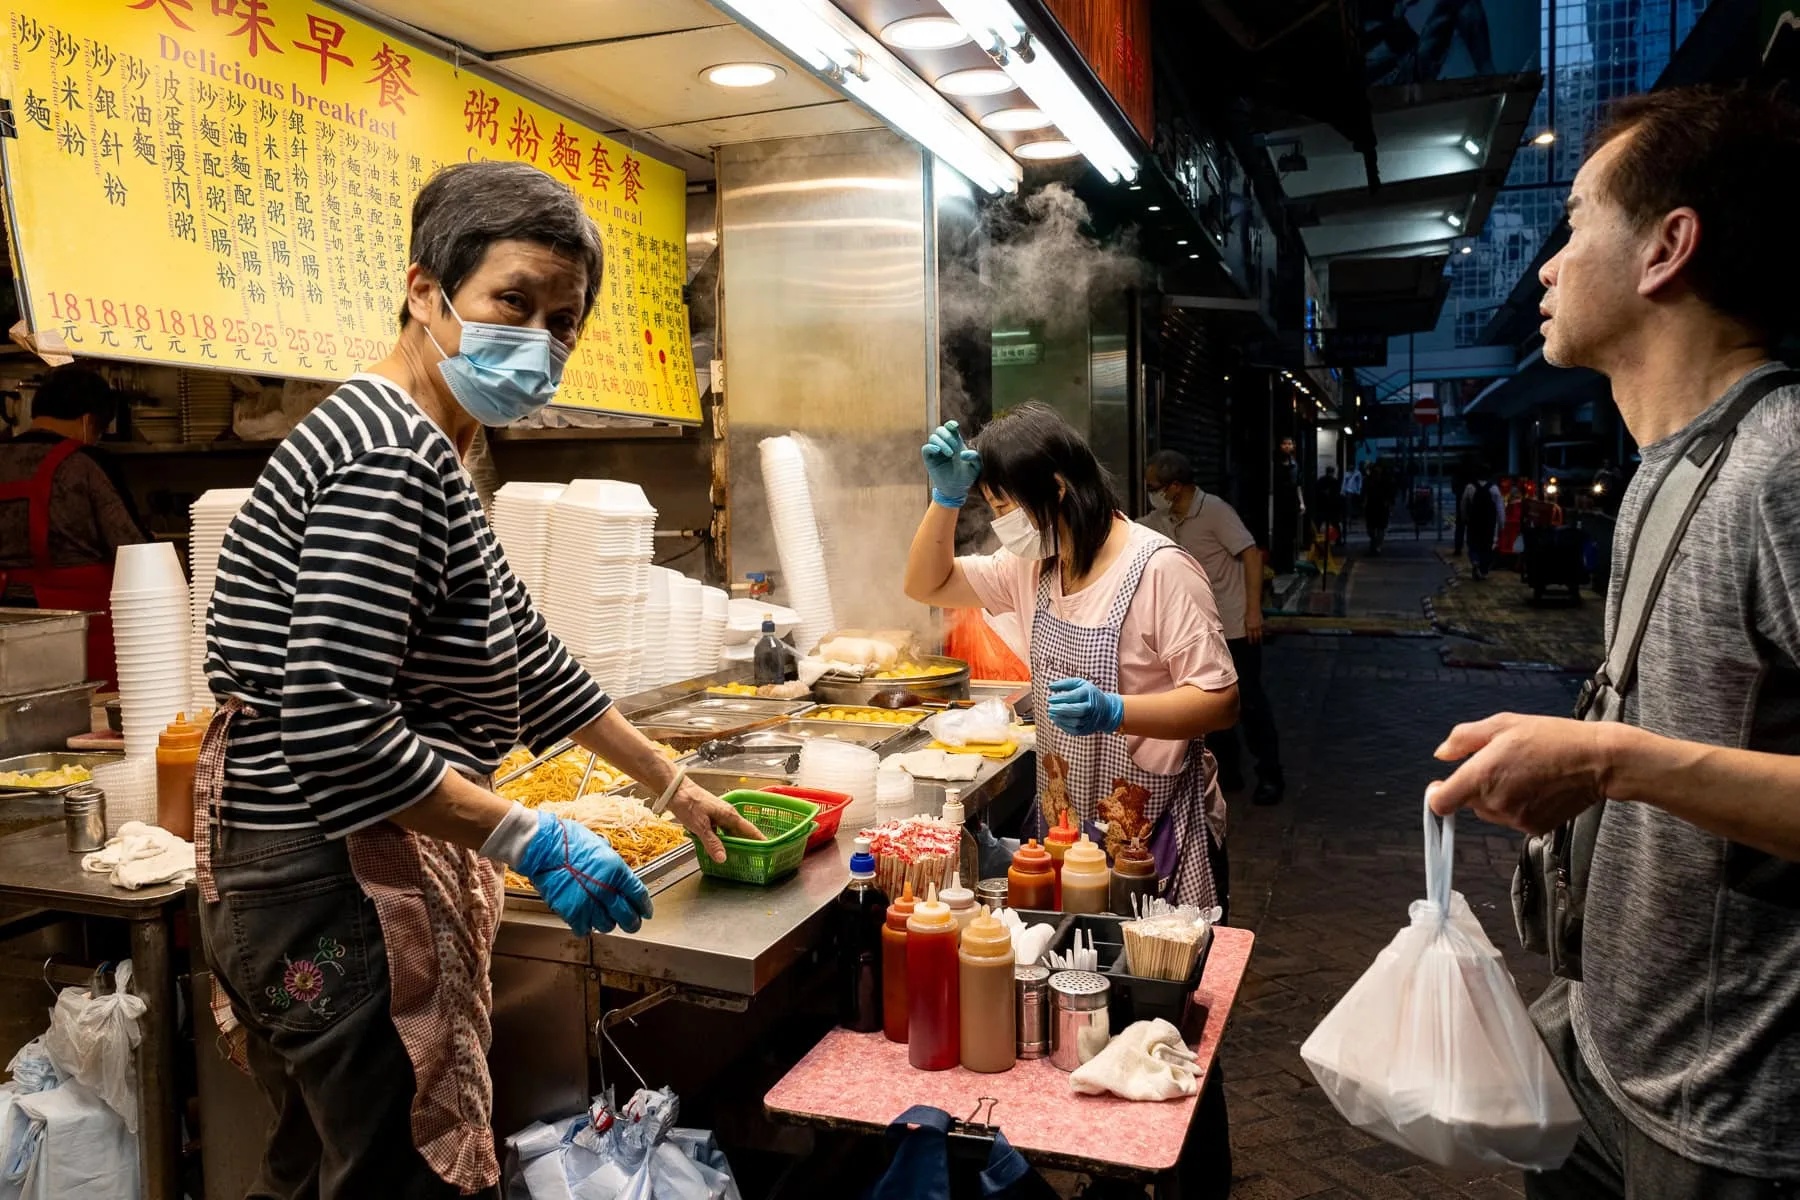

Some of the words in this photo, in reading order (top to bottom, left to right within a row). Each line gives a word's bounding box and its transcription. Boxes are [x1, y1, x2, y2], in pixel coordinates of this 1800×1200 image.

[18, 14, 54, 131] 炒麵
[55, 29, 87, 157] 炒米粉
[158, 33, 285, 100] Delicious
[292, 82, 398, 141] breakfast
[91, 40, 128, 207] 炒銀針粉
[127, 55, 159, 166] 炒油麵
[162, 69, 196, 244] 皮蛋瘦肉粥
[464, 88, 646, 205] 粥粉麵套餐
[588, 196, 608, 215] set
[613, 207, 642, 226] meal
[48, 292, 81, 321] 18
[85, 298, 118, 327] 18
[119, 303, 150, 331] 18
[62, 319, 83, 343] 元
[156, 307, 186, 336] 18
[189, 313, 217, 340] 18
[222, 317, 249, 344] 25
[100, 325, 120, 347] 元
[134, 329, 152, 351] 元
[168, 335, 186, 353] 元
[252, 322, 278, 348] 25
[285, 327, 310, 352] 25
[298, 352, 313, 368] 元
[313, 330, 337, 356] 25
[343, 335, 365, 360] 25
[200, 338, 217, 359] 元
[235, 344, 251, 361] 元
[262, 348, 278, 364] 元
[581, 348, 594, 366] 15
[323, 356, 338, 371] 元
[585, 370, 598, 390] 20
[622, 379, 636, 396] 20
[637, 381, 648, 398] 20
[652, 383, 660, 401] 7
